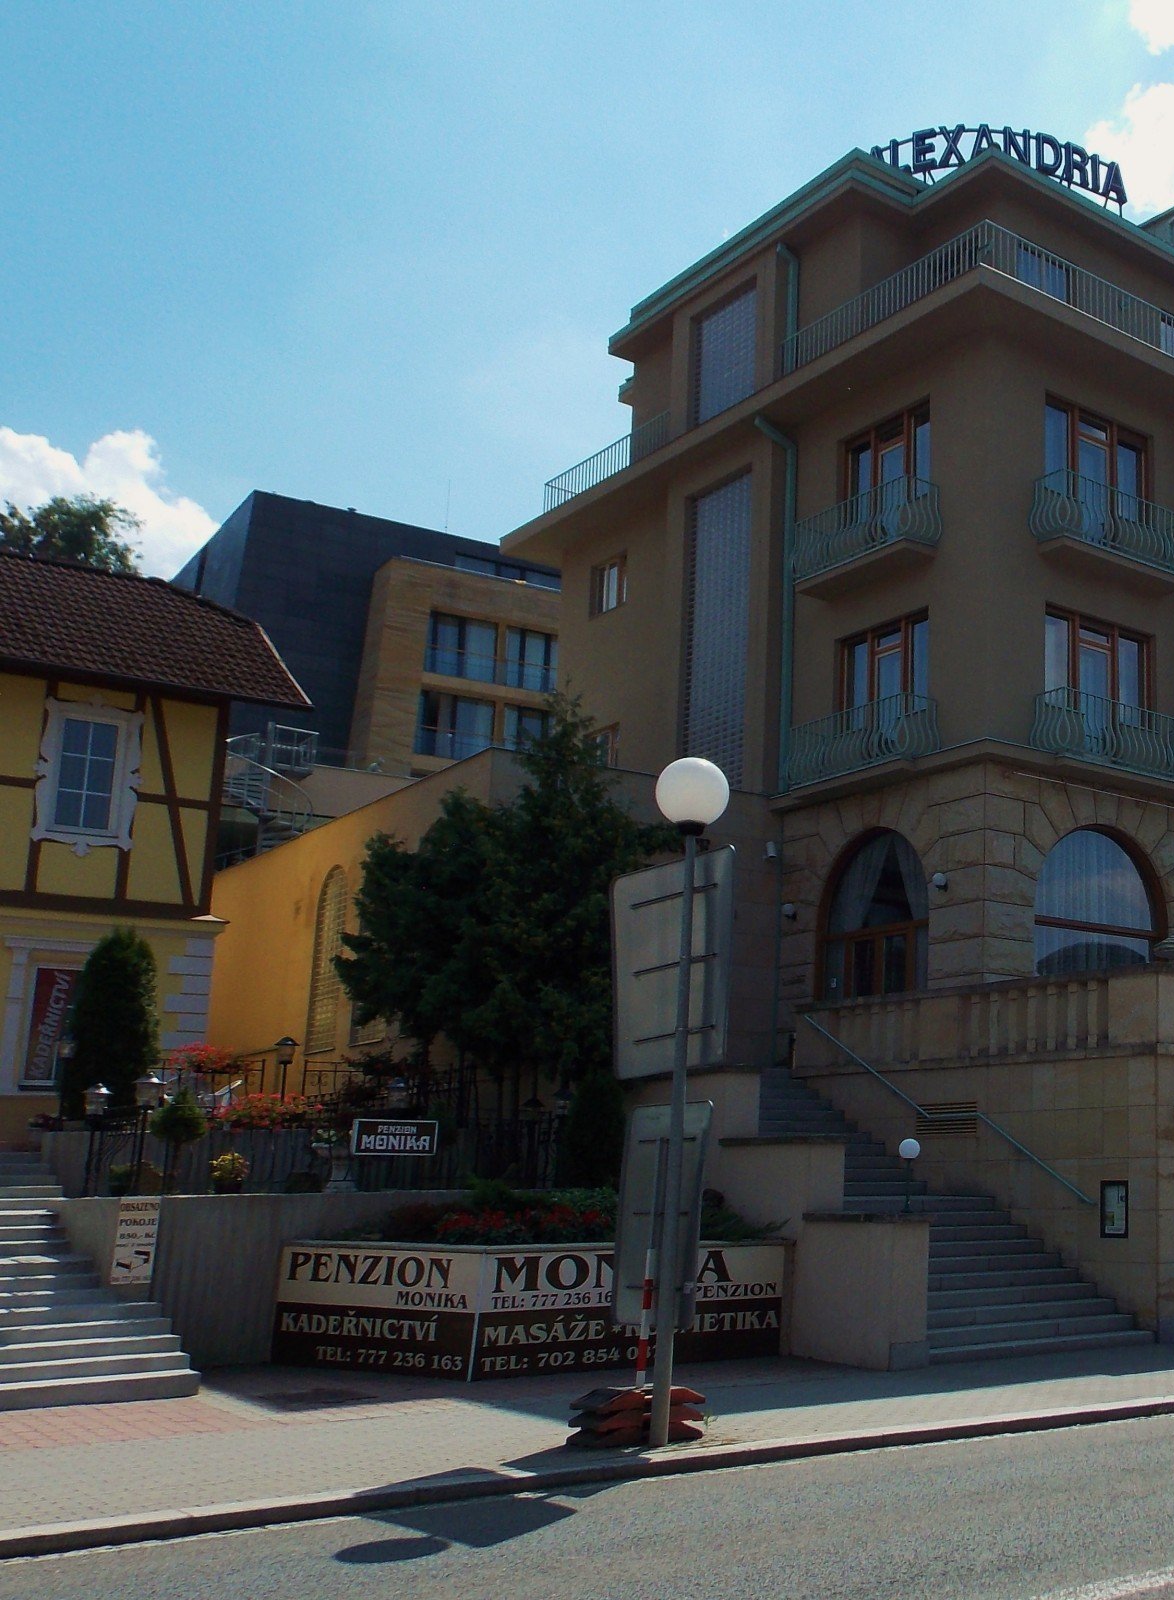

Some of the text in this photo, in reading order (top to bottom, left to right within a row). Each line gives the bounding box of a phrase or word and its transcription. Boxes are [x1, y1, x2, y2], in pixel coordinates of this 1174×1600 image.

[378, 1125, 417, 1134] PENZION
[361, 1135, 430, 1150] MONIKA
[120, 1218, 157, 1227] POKOJE
[287, 1252, 453, 1289] PENZION
[396, 1291, 468, 1309] MONIKA
[491, 1291, 612, 1309] TEL: 777 236 16
[280, 1311, 438, 1342] KADEŘNICTVÍ
[482, 1314, 605, 1347] MASÁŽE
[316, 1346, 463, 1371] TEL: 777 236 163
[481, 1355, 528, 1372] TEL:
[538, 1351, 576, 1367] 702
[583, 1347, 620, 1363] 854
